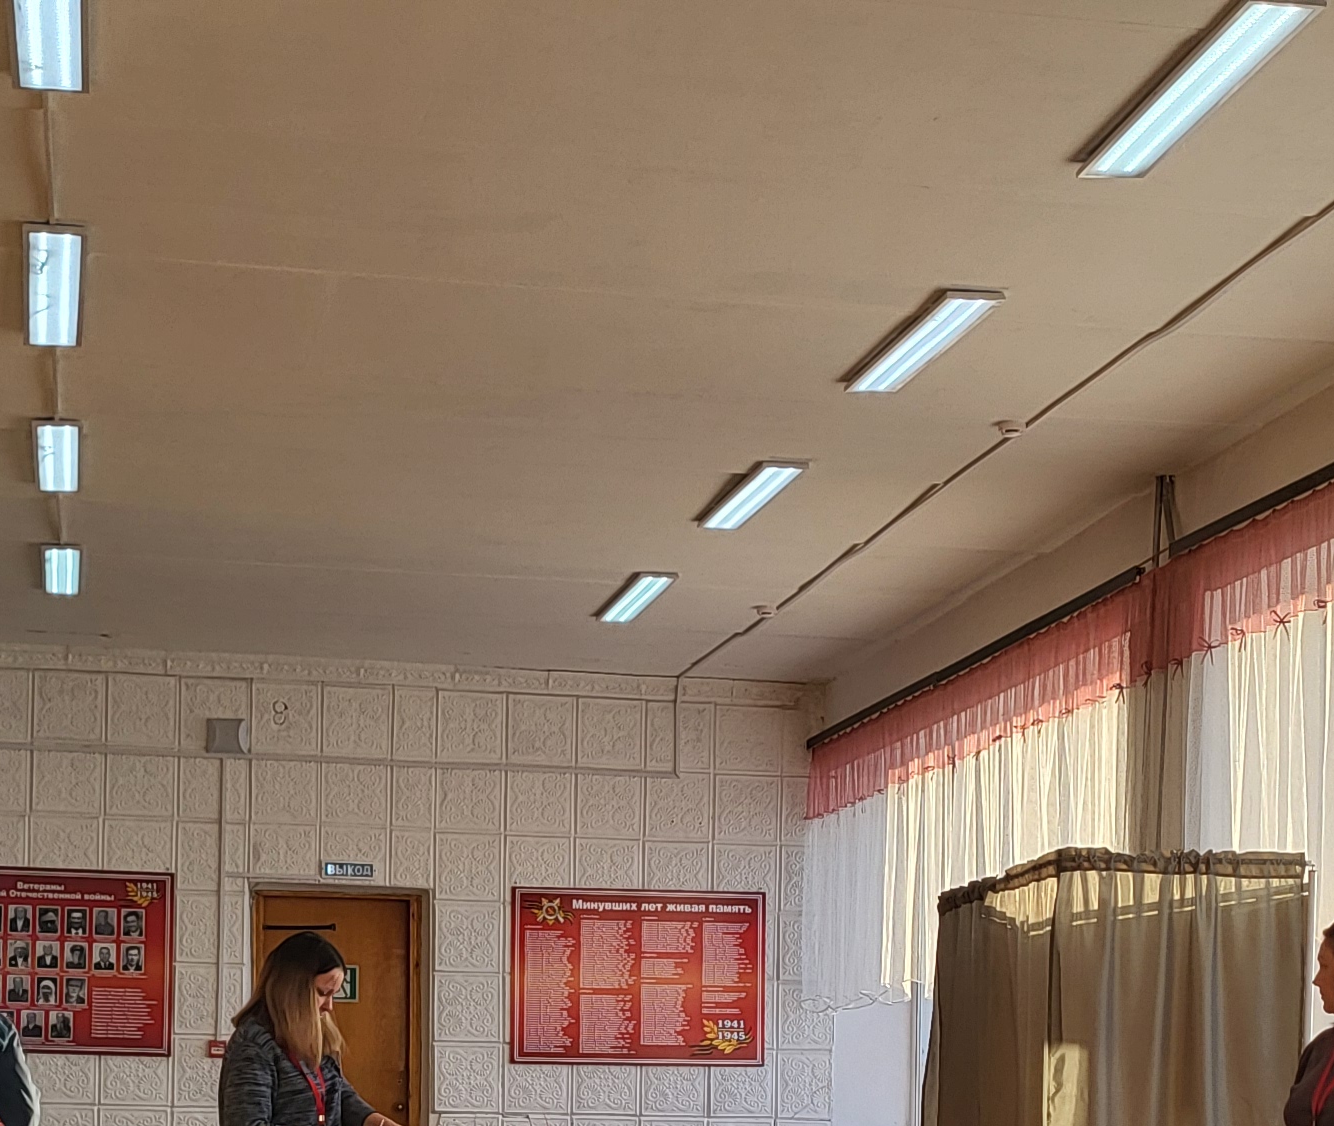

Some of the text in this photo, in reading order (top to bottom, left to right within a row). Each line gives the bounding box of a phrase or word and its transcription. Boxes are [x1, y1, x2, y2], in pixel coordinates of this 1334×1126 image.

[17, 881, 64, 891] Ветераны
[9, 889, 81, 900] Отечественной
[84, 892, 114, 901] войны
[572, 899, 752, 913] Минувших лет живая память
[717, 1019, 745, 1028] 1941
[718, 1031, 746, 1040] 1945
